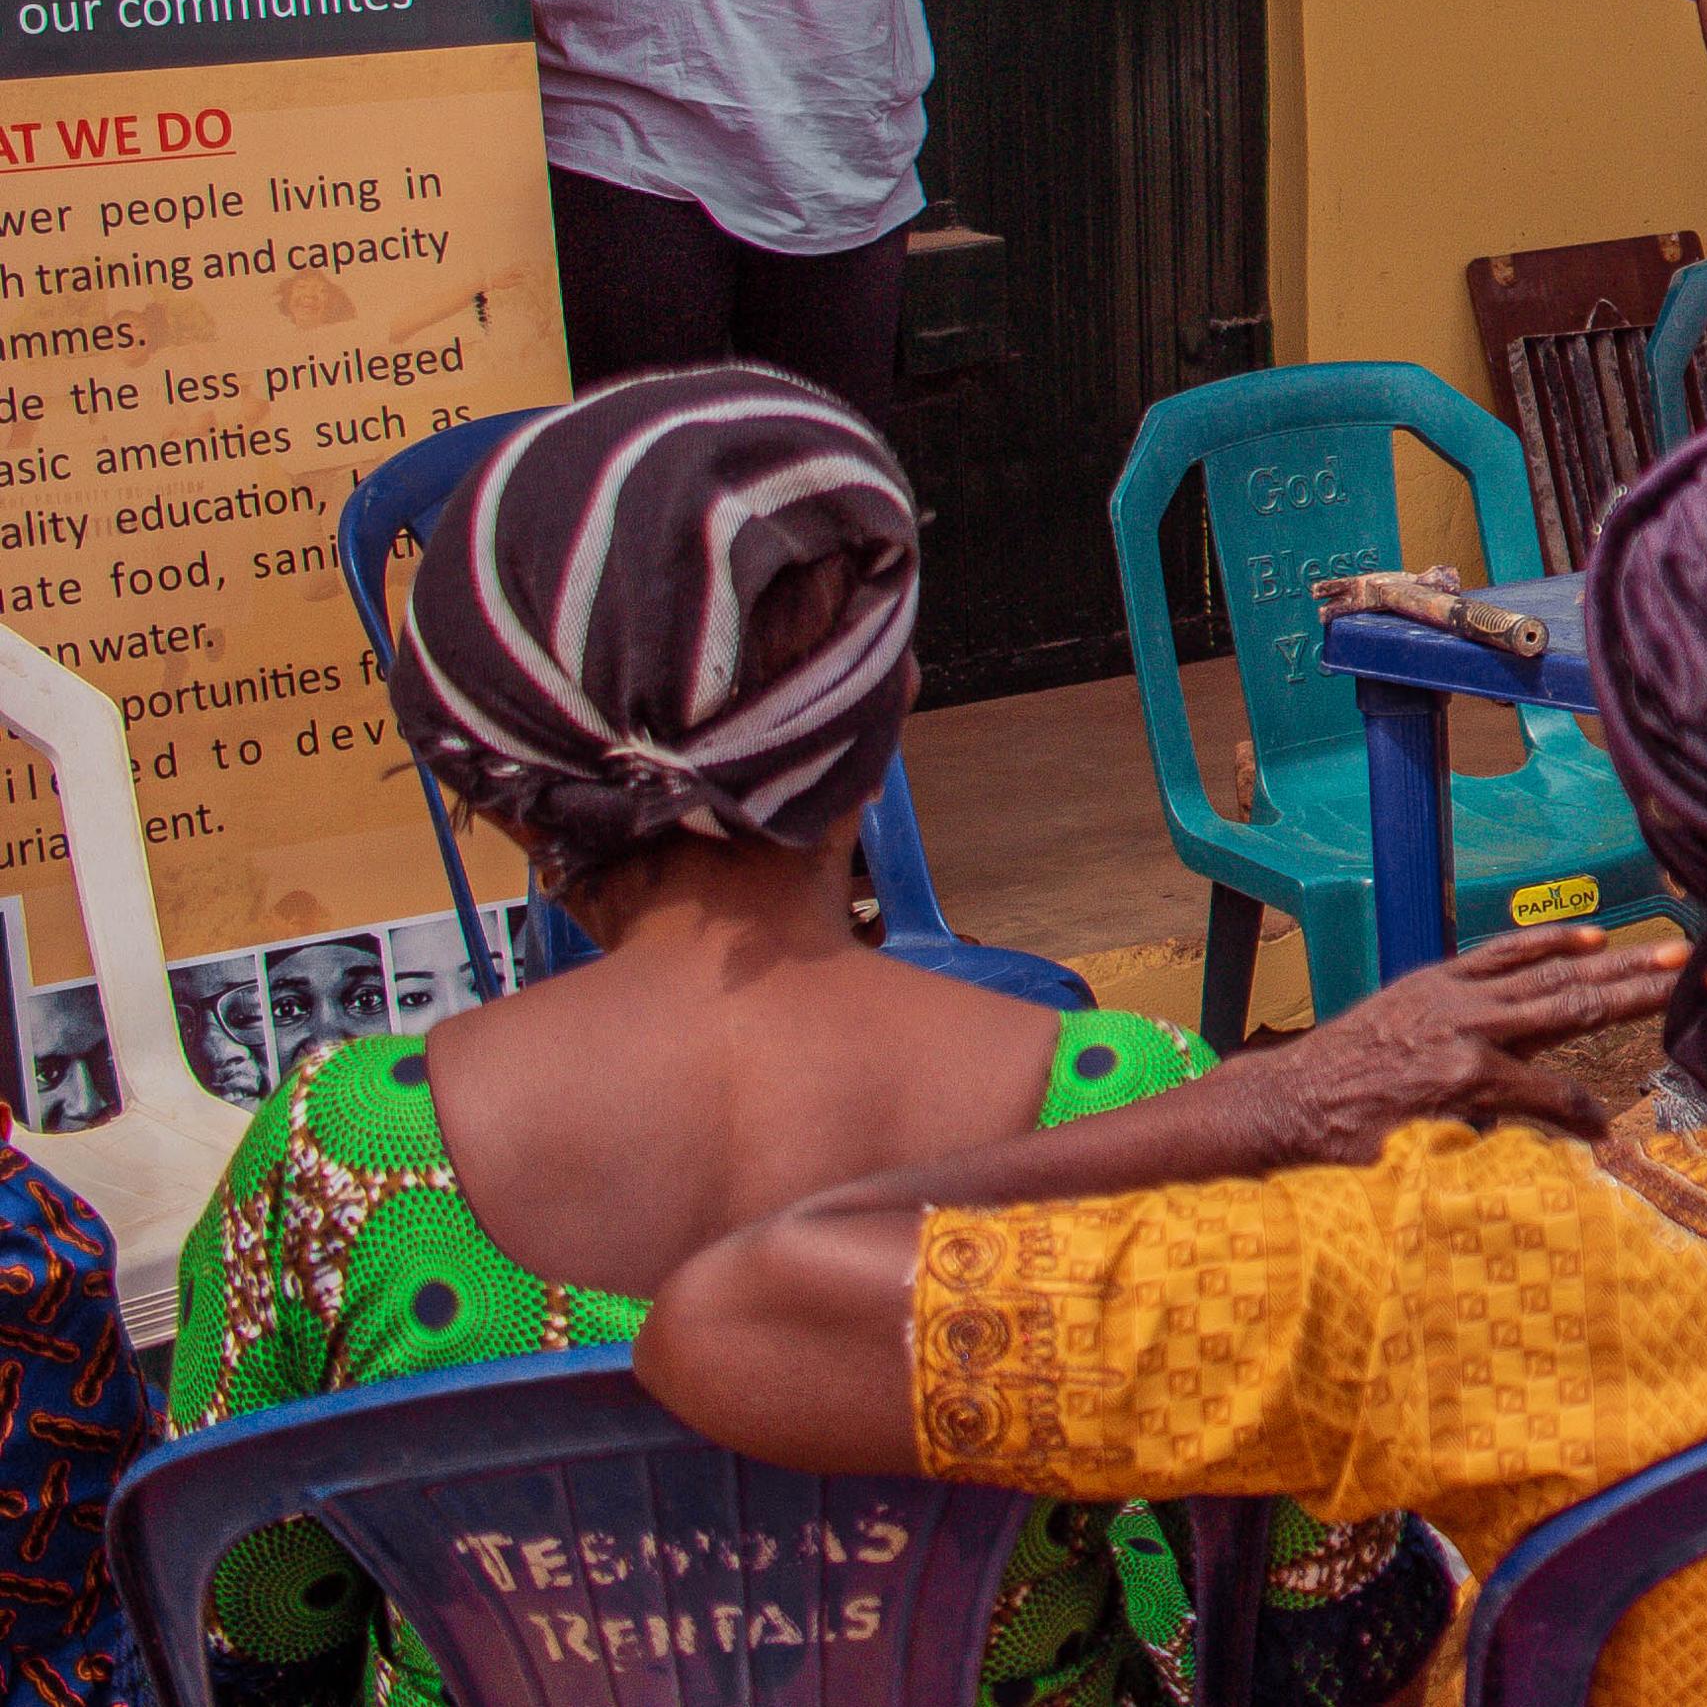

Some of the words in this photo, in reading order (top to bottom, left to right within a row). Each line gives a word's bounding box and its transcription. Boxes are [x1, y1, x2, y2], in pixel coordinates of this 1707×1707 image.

[56, 114, 142, 161] WE
[157, 108, 234, 154] DO
[101, 183, 244, 237] people
[270, 175, 381, 214] living
[406, 166, 443, 201] in
[35, 256, 195, 297] training
[203, 239, 277, 281] and
[287, 228, 452, 274] capacity
[70, 377, 140, 417] the
[165, 369, 242, 405] less
[265, 337, 466, 396] privileged
[95, 424, 292, 476] amenities
[315, 405, 407, 449] such
[116, 483, 328, 536] education,
[1249, 455, 1349, 515] God
[110, 549, 226, 599] food,
[1248, 547, 1380, 603] Bless
[90, 621, 214, 665] water.
[122, 662, 341, 731] portunities
[212, 737, 263, 770] to
[1518, 891, 1595, 917] PAPILON
